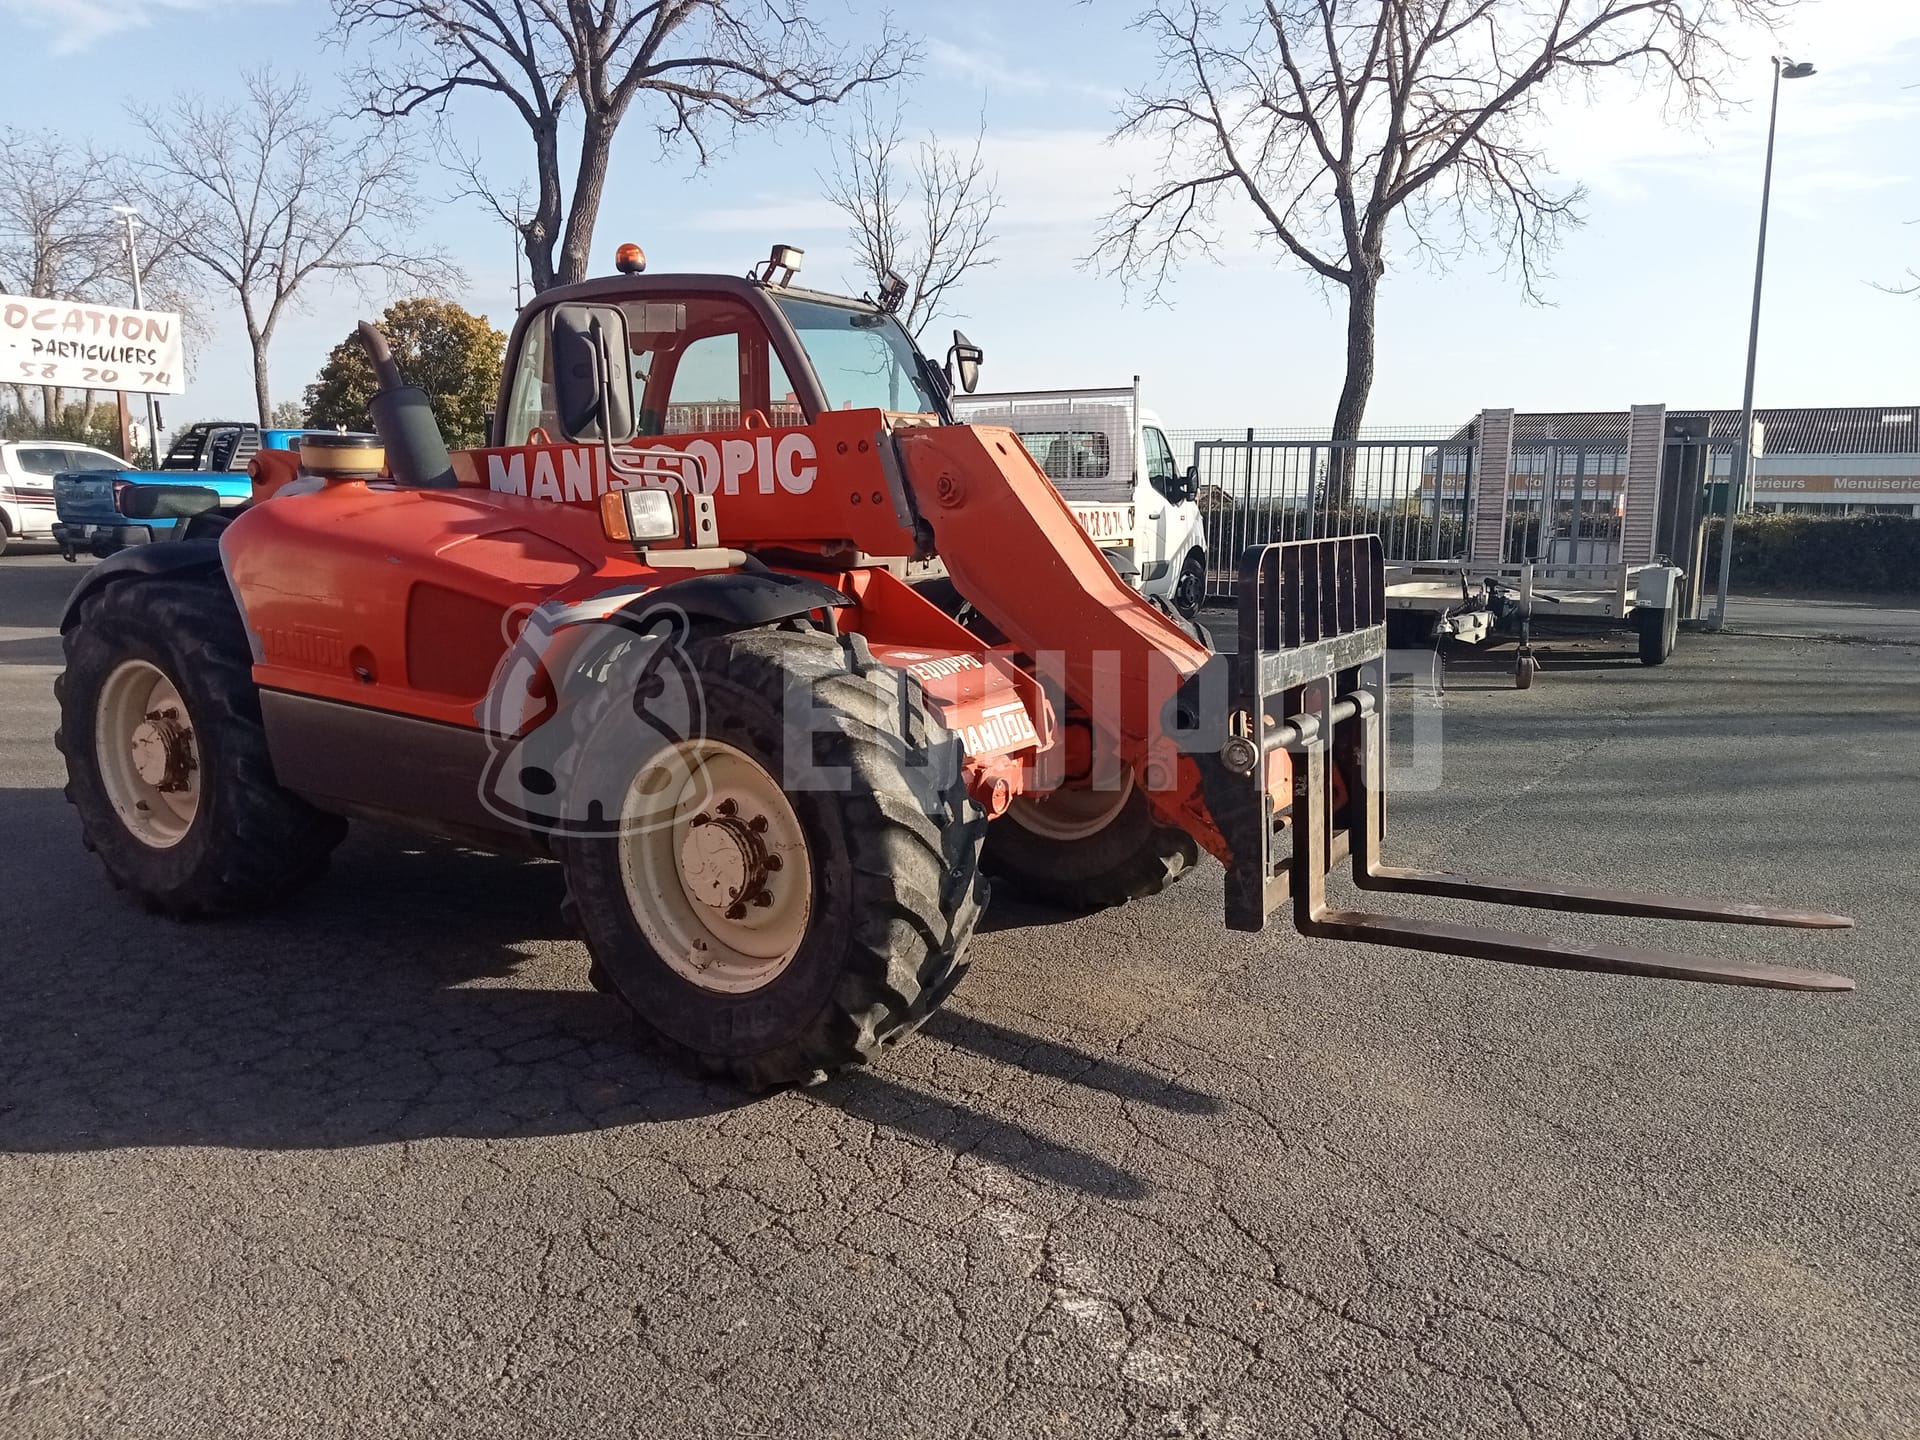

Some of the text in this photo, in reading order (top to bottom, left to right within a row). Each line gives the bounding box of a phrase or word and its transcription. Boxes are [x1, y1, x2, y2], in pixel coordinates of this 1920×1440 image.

[4, 303, 169, 343] OCATION
[31, 338, 157, 366] PARTICULIERS
[82, 367, 119, 383] 20
[139, 371, 172, 386] 74
[488, 433, 818, 502] MANISCOPIC
